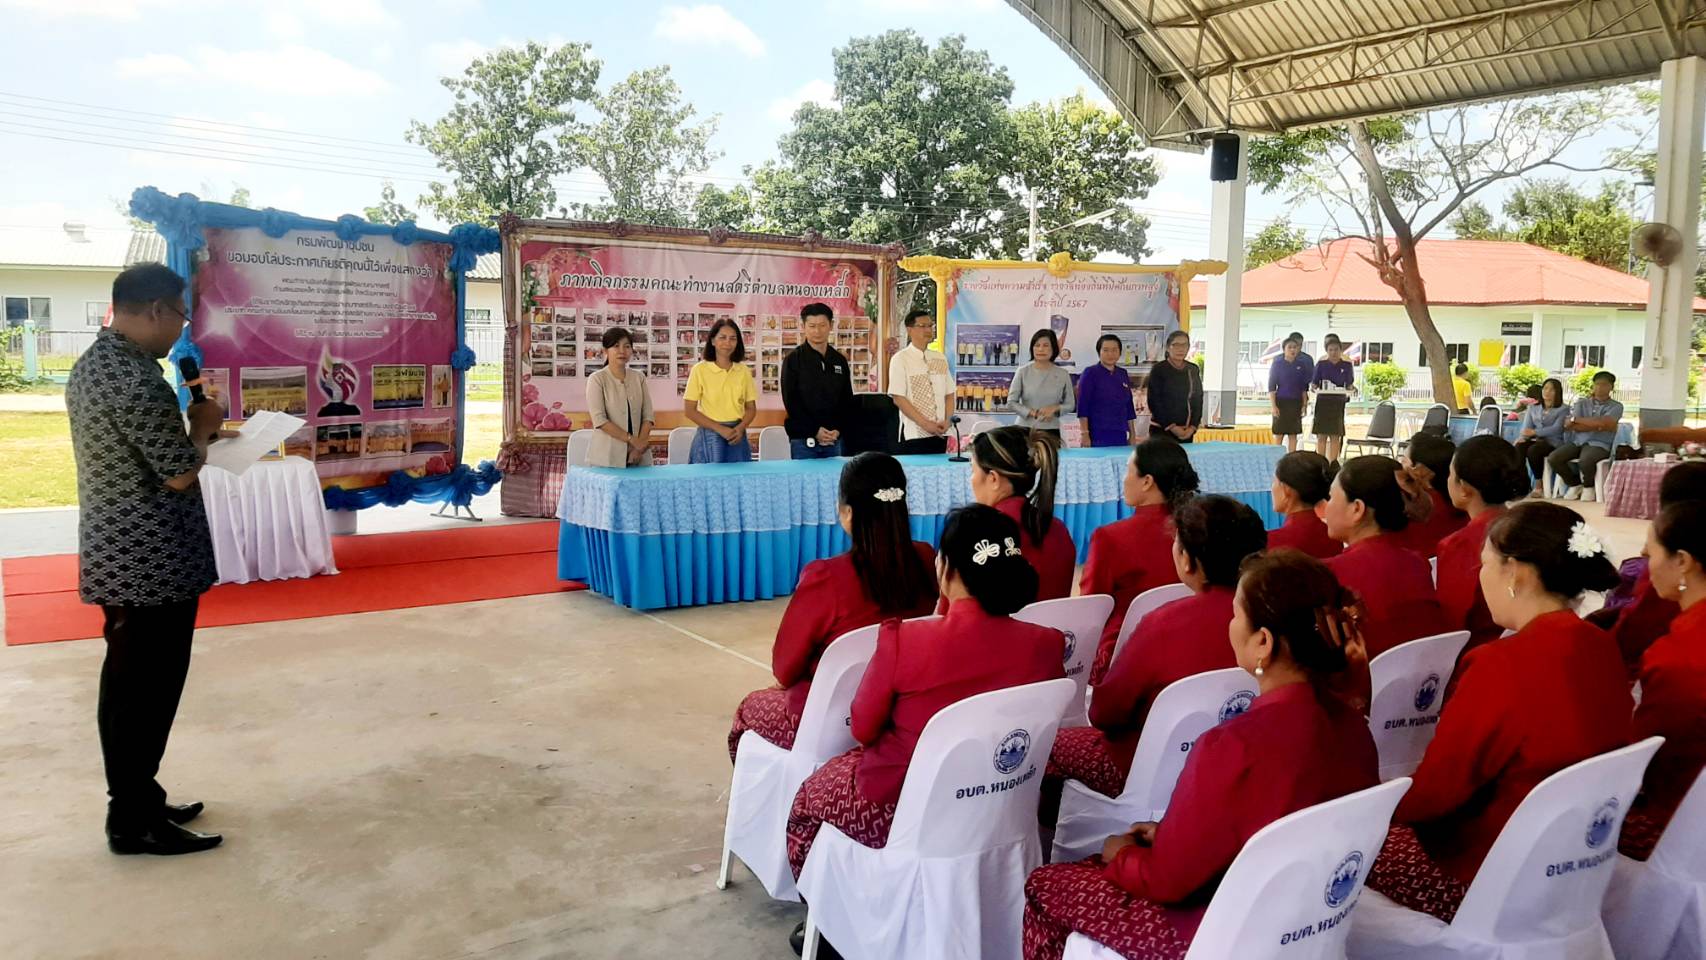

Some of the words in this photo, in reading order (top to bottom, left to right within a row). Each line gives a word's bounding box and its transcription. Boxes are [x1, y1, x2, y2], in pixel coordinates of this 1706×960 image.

[559, 260, 851, 298] ภาพกิจกรรมคณะทำงานสตรีตำบลหนองเหล็ก
[1066, 299, 1089, 309] 2567
[955, 764, 1037, 799] อบต.หนองเหล็ก
